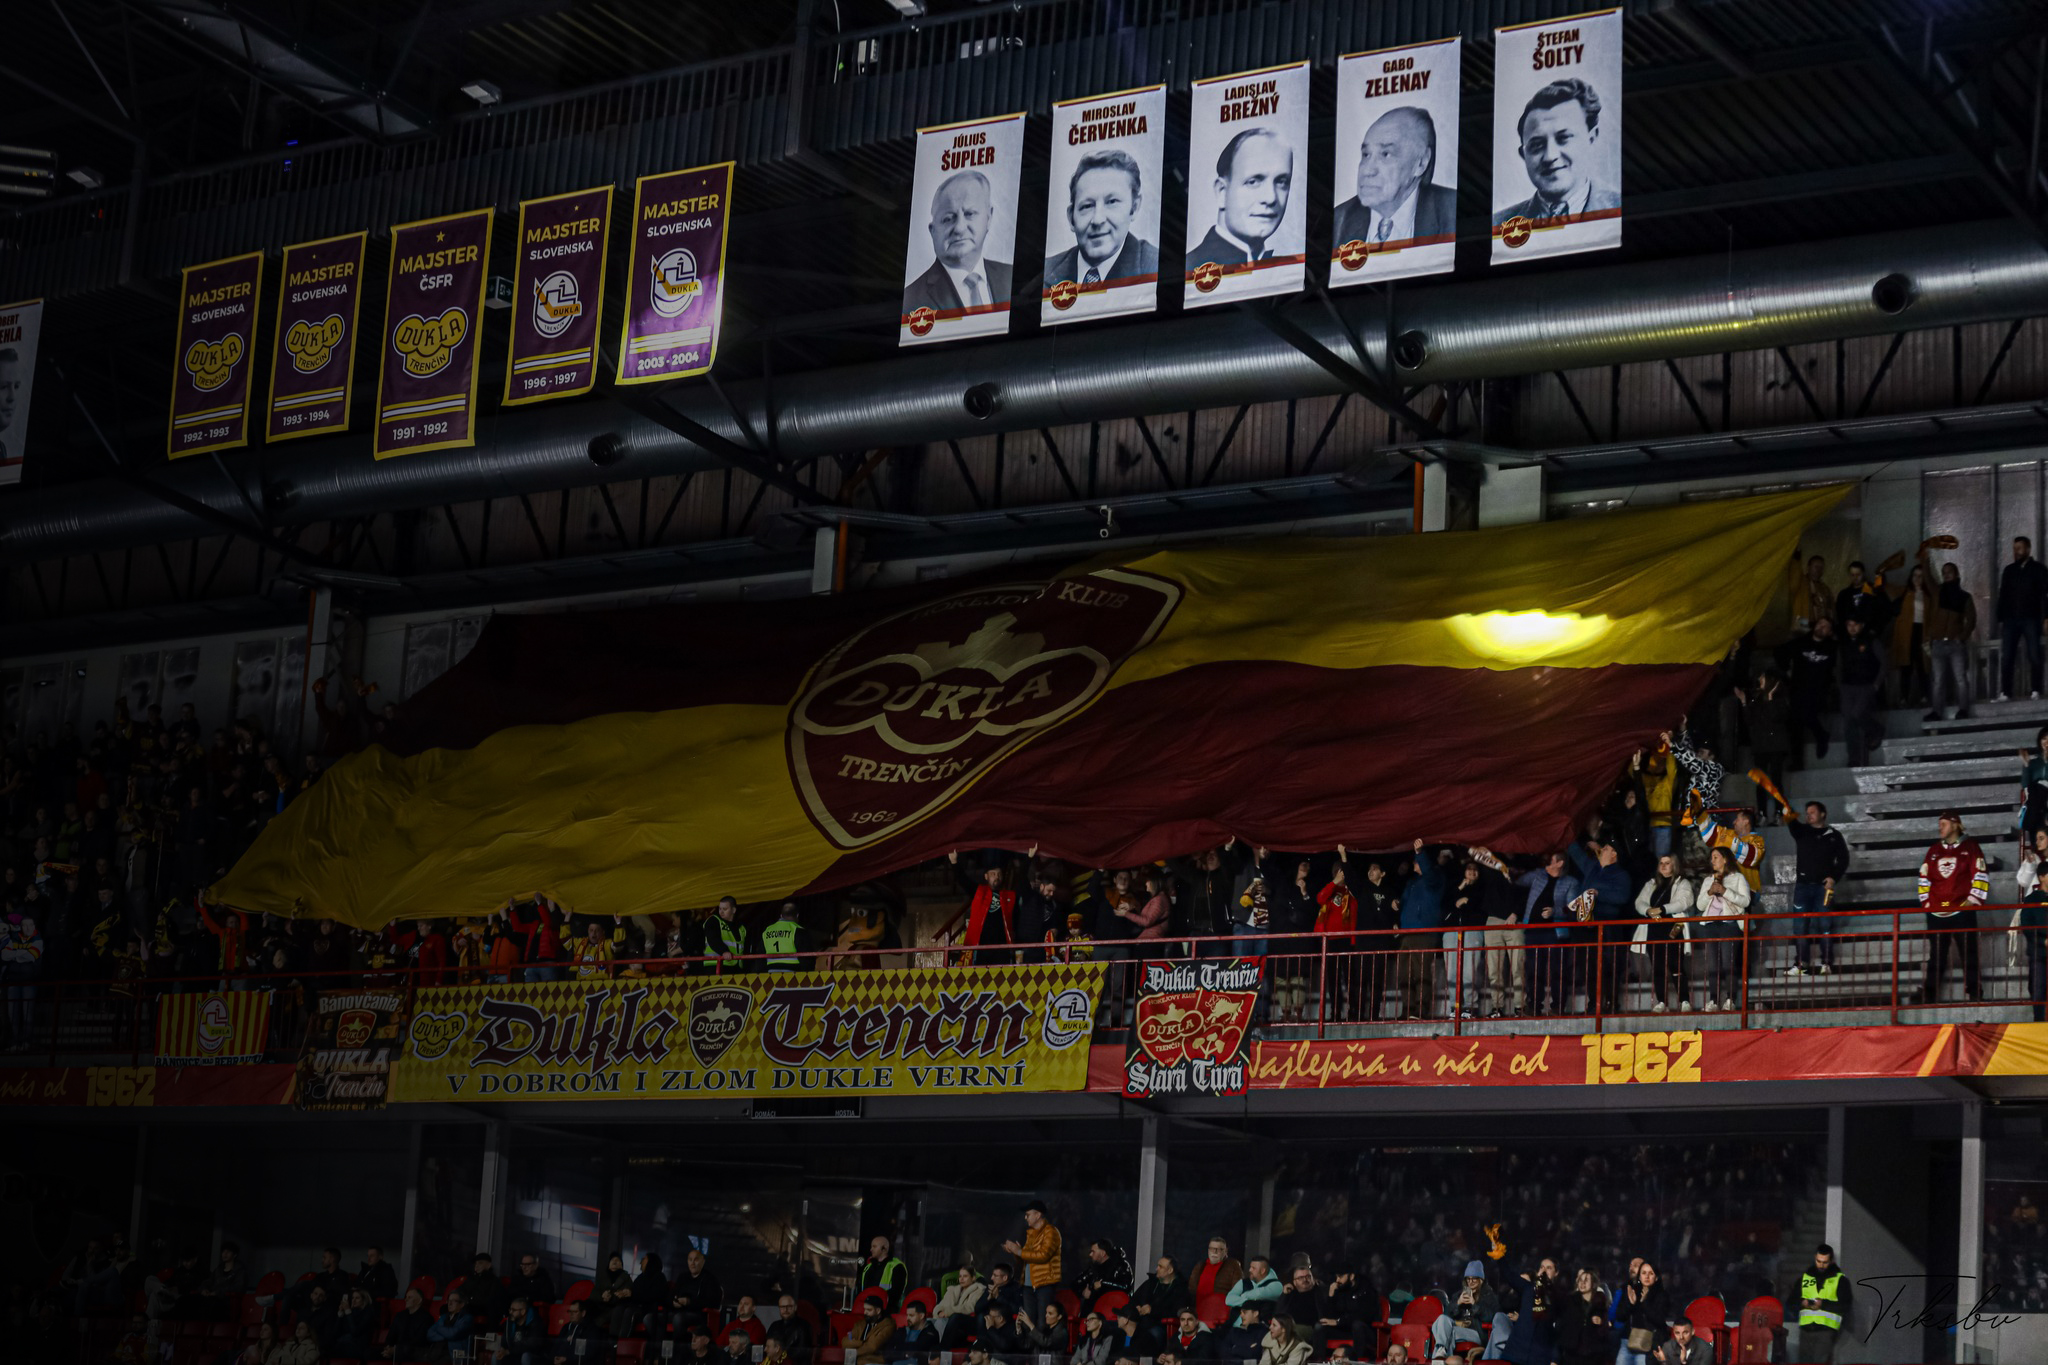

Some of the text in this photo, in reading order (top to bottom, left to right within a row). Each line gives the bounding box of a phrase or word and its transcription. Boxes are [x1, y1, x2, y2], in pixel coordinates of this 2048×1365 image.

[1537, 28, 1580, 51] ŠTEFAN
[1382, 57, 1414, 74] GABO
[1532, 44, 1585, 71] ŠOLTY
[1225, 80, 1276, 101] LADISLAV
[1365, 70, 1431, 99] ZELENAY
[1082, 102, 1136, 123] MIROSLAV
[1220, 92, 1279, 123] BREŽNÝ
[953, 132, 986, 149] JÚLIUS
[1068, 116, 1148, 146] ČERVENKA
[941, 146, 996, 171] ŠUPLER
[643, 193, 720, 220] MAJSTER
[526, 217, 601, 244] MAJSTER
[646, 217, 713, 238] SLOVENSKA
[399, 245, 479, 275] MAJSTER
[529, 240, 594, 261] SLOVENSKA
[289, 262, 355, 288] MAJSTER
[419, 273, 454, 291] ČSFR
[188, 281, 252, 309] MAJSTER
[291, 283, 348, 304] SLOVENSKA
[671, 284, 699, 295] DUKLA
[191, 303, 246, 325] SLOVENSKA
[553, 305, 580, 316] DUKLA
[290, 322, 340, 348] DUKLA
[399, 318, 462, 347] DUKLA
[190, 340, 239, 366] DUKLA
[297, 352, 329, 369] TRENČÍN
[409, 353, 447, 373] TRENČÍN
[637, 355, 665, 371] 2003
[672, 350, 700, 366] 2004
[197, 371, 228, 388] TRENČÍN
[523, 376, 547, 390] 1996
[554, 371, 577, 386] 1997
[282, 414, 302, 427] 1993
[309, 409, 330, 423] 1994
[183, 431, 203, 444] 1992
[209, 426, 230, 440] 1993
[392, 429, 415, 441] 1991
[423, 421, 448, 436] 1992
[1057, 580, 1130, 609] KLUB
[834, 670, 1052, 721] DUKLA
[837, 754, 973, 784] TRENČÍN
[848, 811, 898, 825] 1962
[765, 930, 792, 939] SECURITY
[772, 940, 780, 953] 1
[1144, 962, 1260, 993] Dukla Trenčín
[320, 993, 401, 1014] Bánovčania
[415, 1020, 460, 1038] DUKLA
[470, 988, 678, 1076] Dukla
[695, 1020, 736, 1034] DUKLA
[760, 982, 1033, 1067] Trenčín
[1062, 1021, 1089, 1030] DUKLA
[1146, 1018, 1195, 1036] DUKLA
[1401, 1056, 1421, 1076] u
[1433, 1041, 1493, 1077] nás
[1510, 1035, 1550, 1075] od
[1582, 1031, 1703, 1085] 1962
[0, 1066, 157, 1106] nás od 1962
[447, 1060, 1026, 1094] V DOBROM I ZLOM DUKLE VERNÍ
[1127, 1061, 1188, 1093] Stará
[1803, 1278, 1817, 1288] 25
